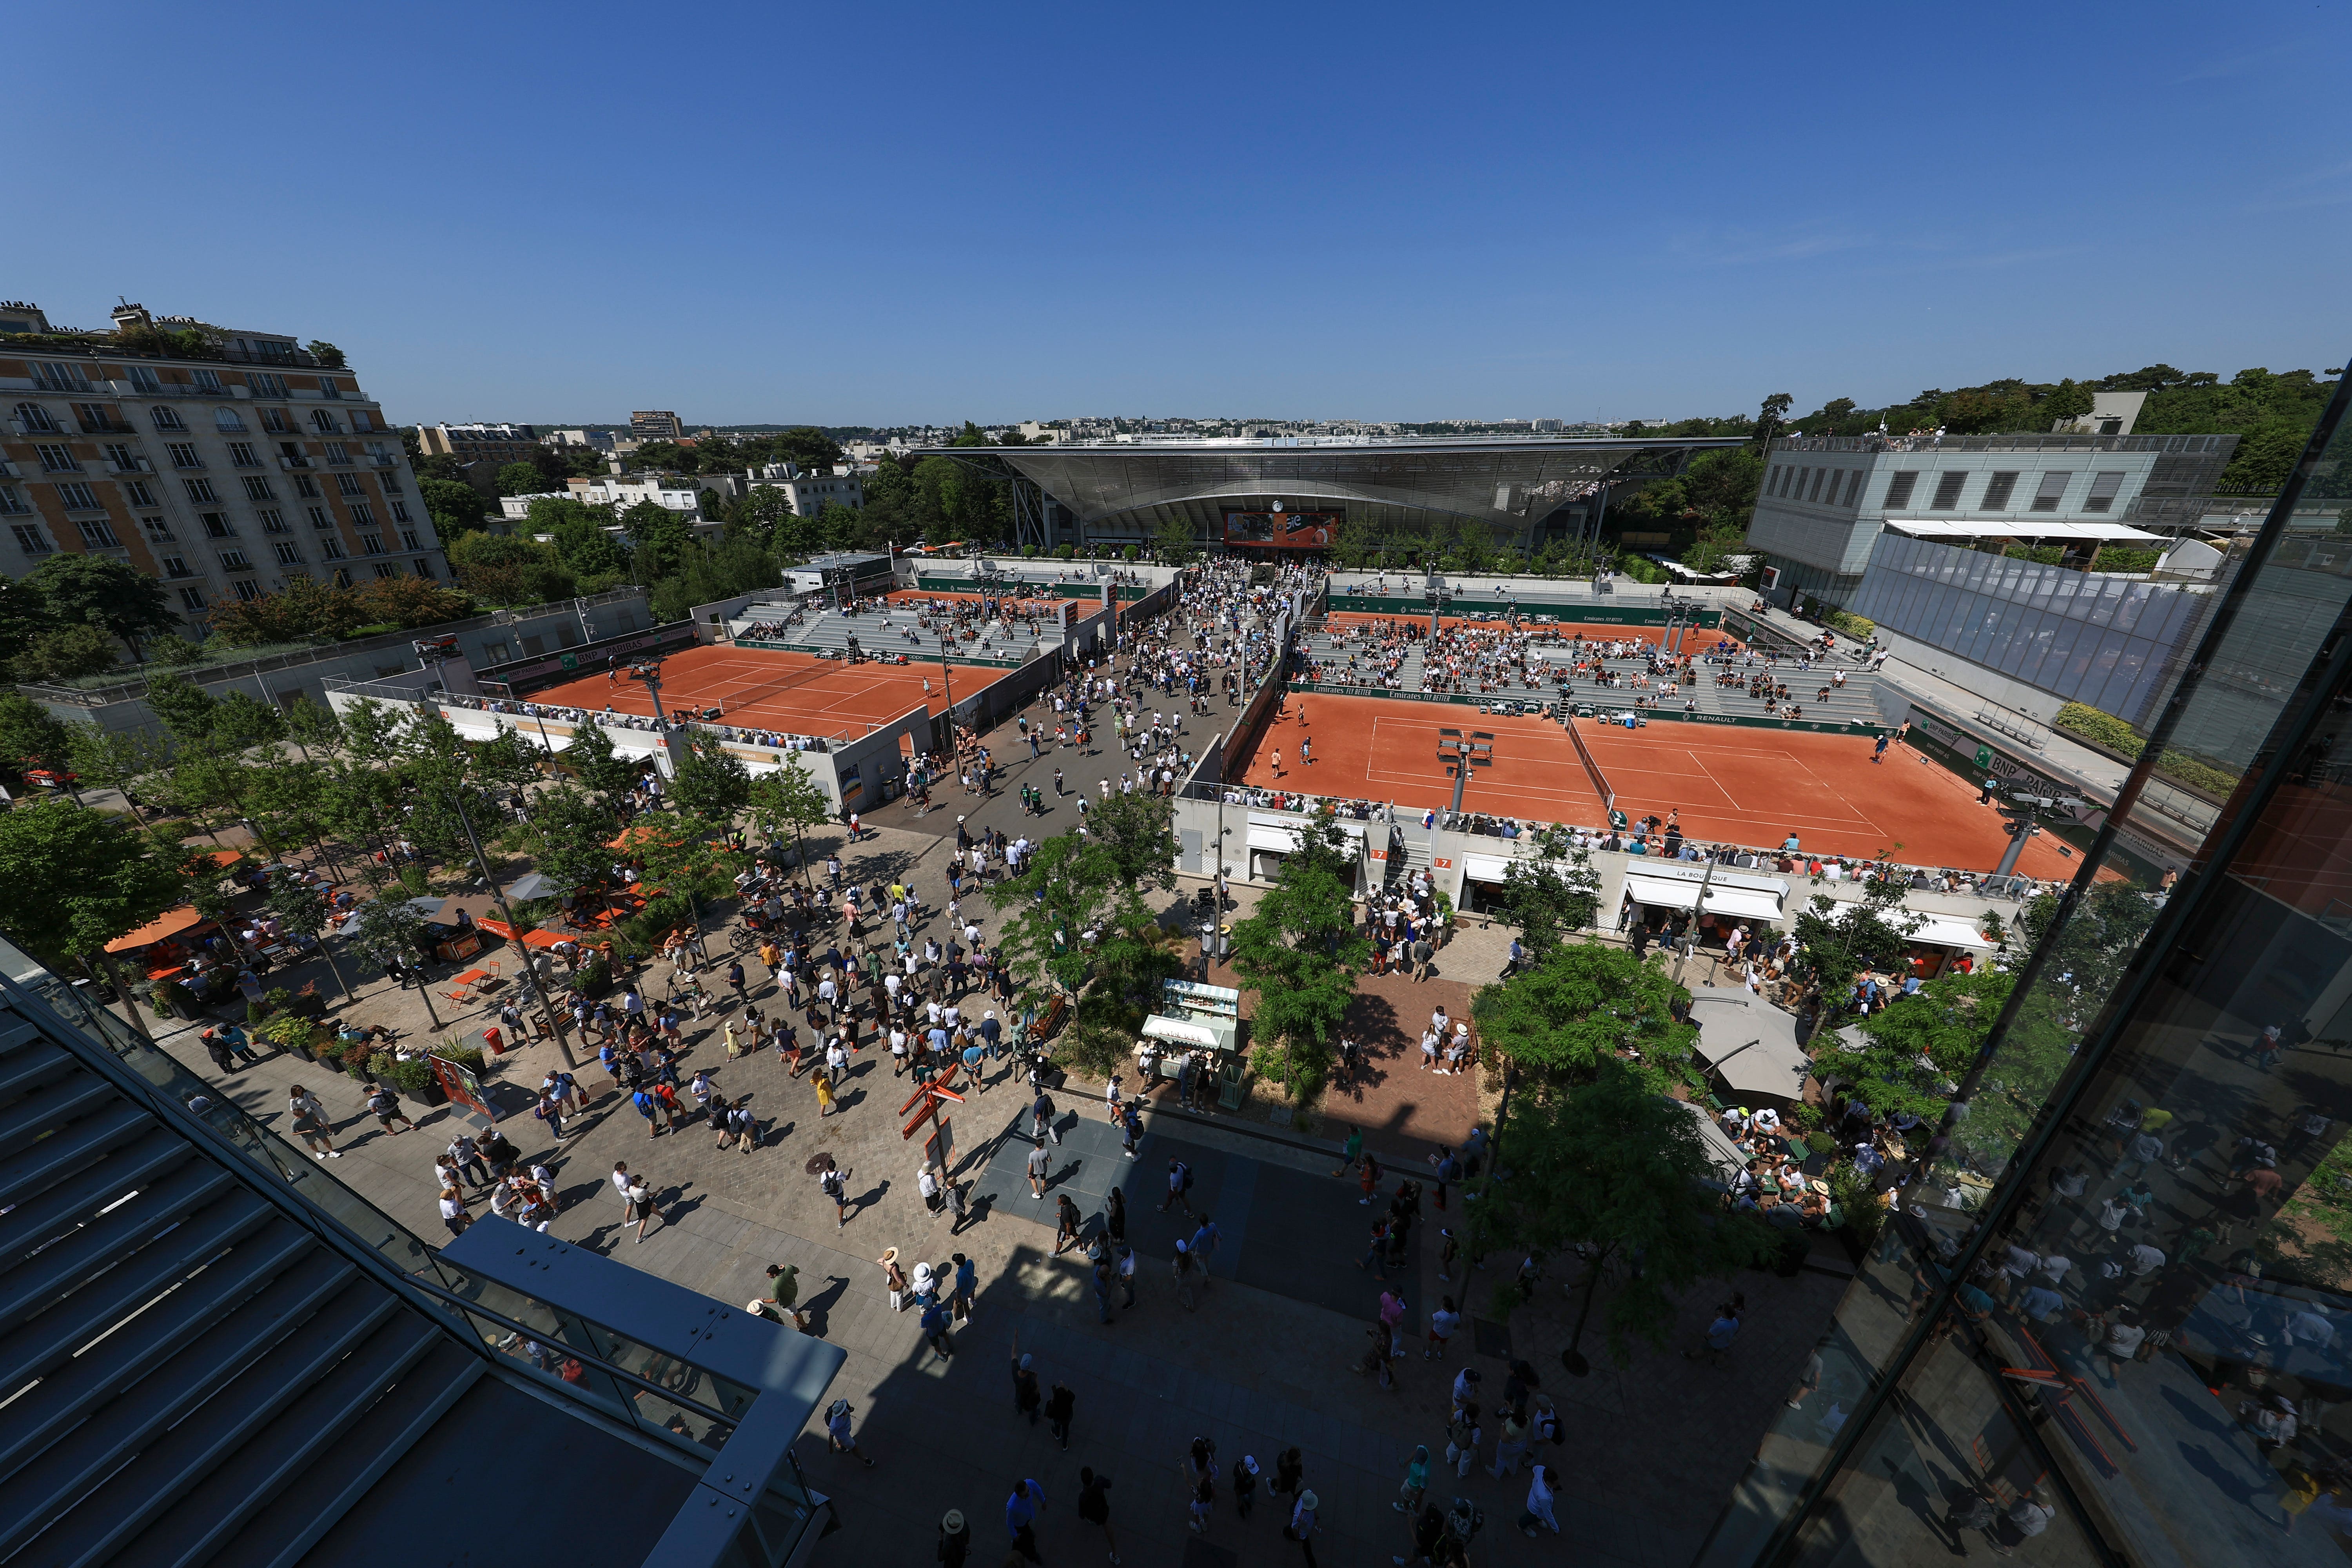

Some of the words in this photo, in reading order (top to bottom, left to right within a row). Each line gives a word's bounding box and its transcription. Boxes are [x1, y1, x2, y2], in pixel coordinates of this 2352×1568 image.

[1755, 627, 1764, 637] BNP
[1766, 633, 1785, 649] PARIBAS
[578, 651, 597, 663] BNP
[606, 640, 642, 655] PARIBAS
[522, 664, 545, 673] PARIBAS
[1314, 685, 1344, 694] Emirates
[1389, 691, 1421, 700] Emirates
[1467, 697, 1492, 705] oppo
[1929, 722, 1938, 732] BNP
[1938, 726, 1957, 742] PARIBAS
[1934, 746, 1950, 759] PARIBAS
[1992, 757, 2016, 777] BNP
[1973, 770, 1982, 779] BNP
[2130, 835, 2165, 858] PARIBAS
[2107, 850, 2130, 866] ARIBAS
[1688, 873, 1728, 882] BOUQUE
[484, 923, 499, 933] Sortie
